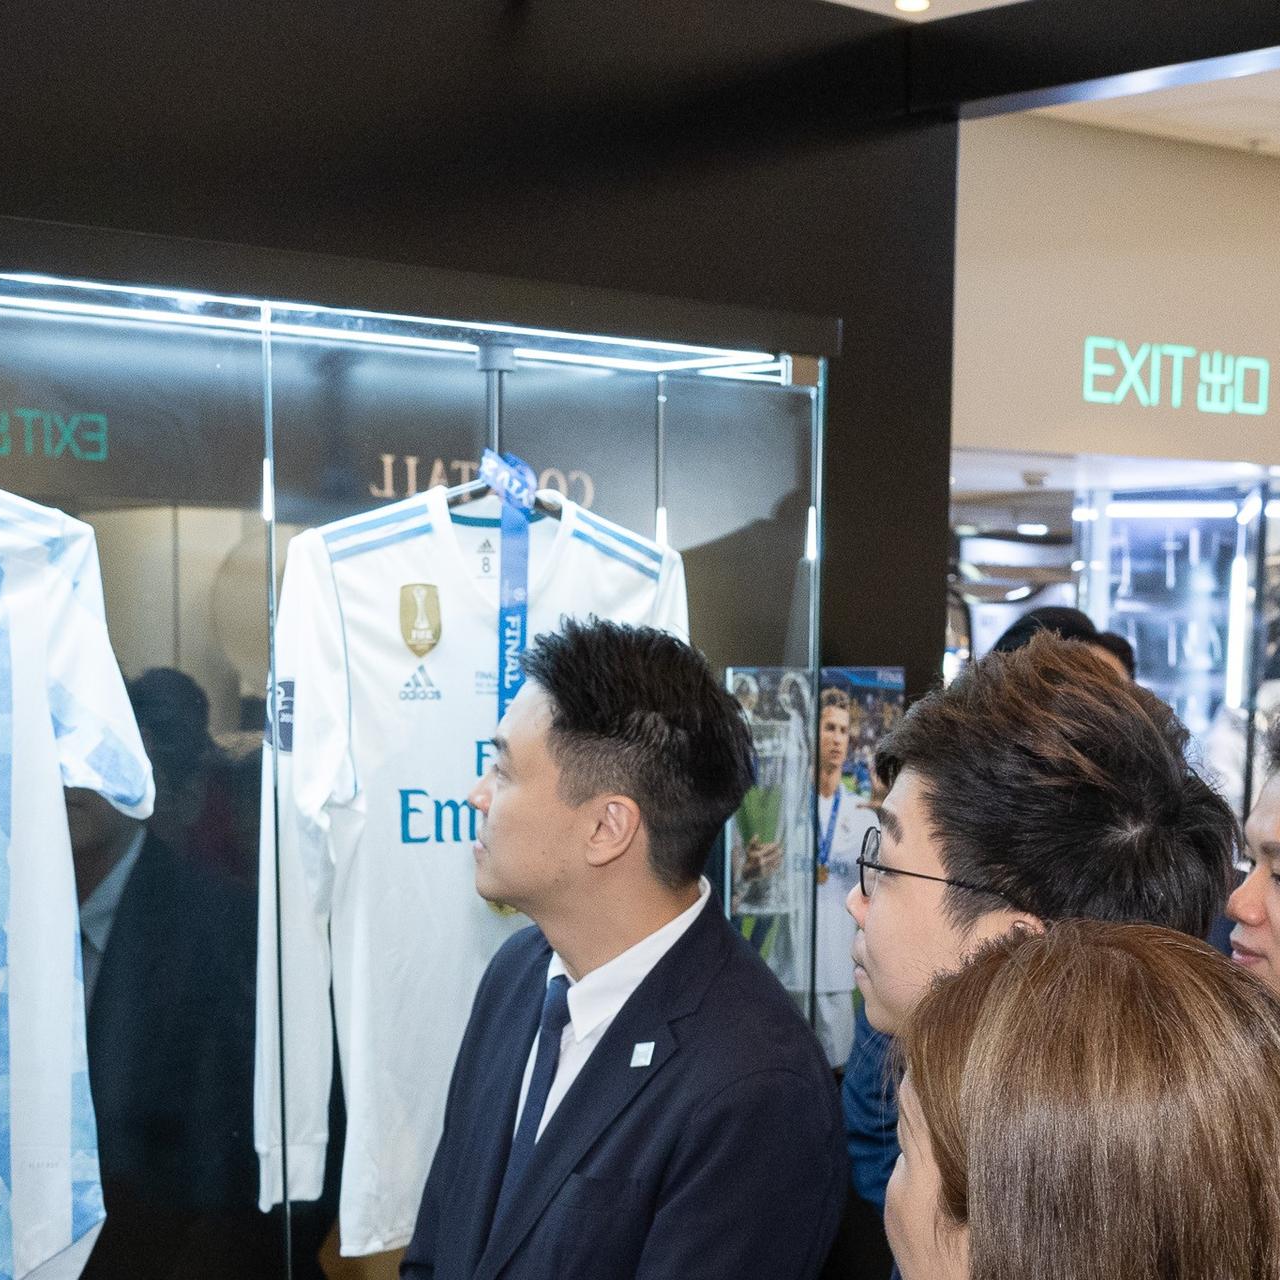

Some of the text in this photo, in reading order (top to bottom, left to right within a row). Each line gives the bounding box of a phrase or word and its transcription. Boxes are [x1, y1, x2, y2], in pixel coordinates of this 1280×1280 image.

[1083, 335, 1270, 416] EXIT 出口
[504, 615, 521, 690] FINAL
[399, 687, 442, 701] adidas
